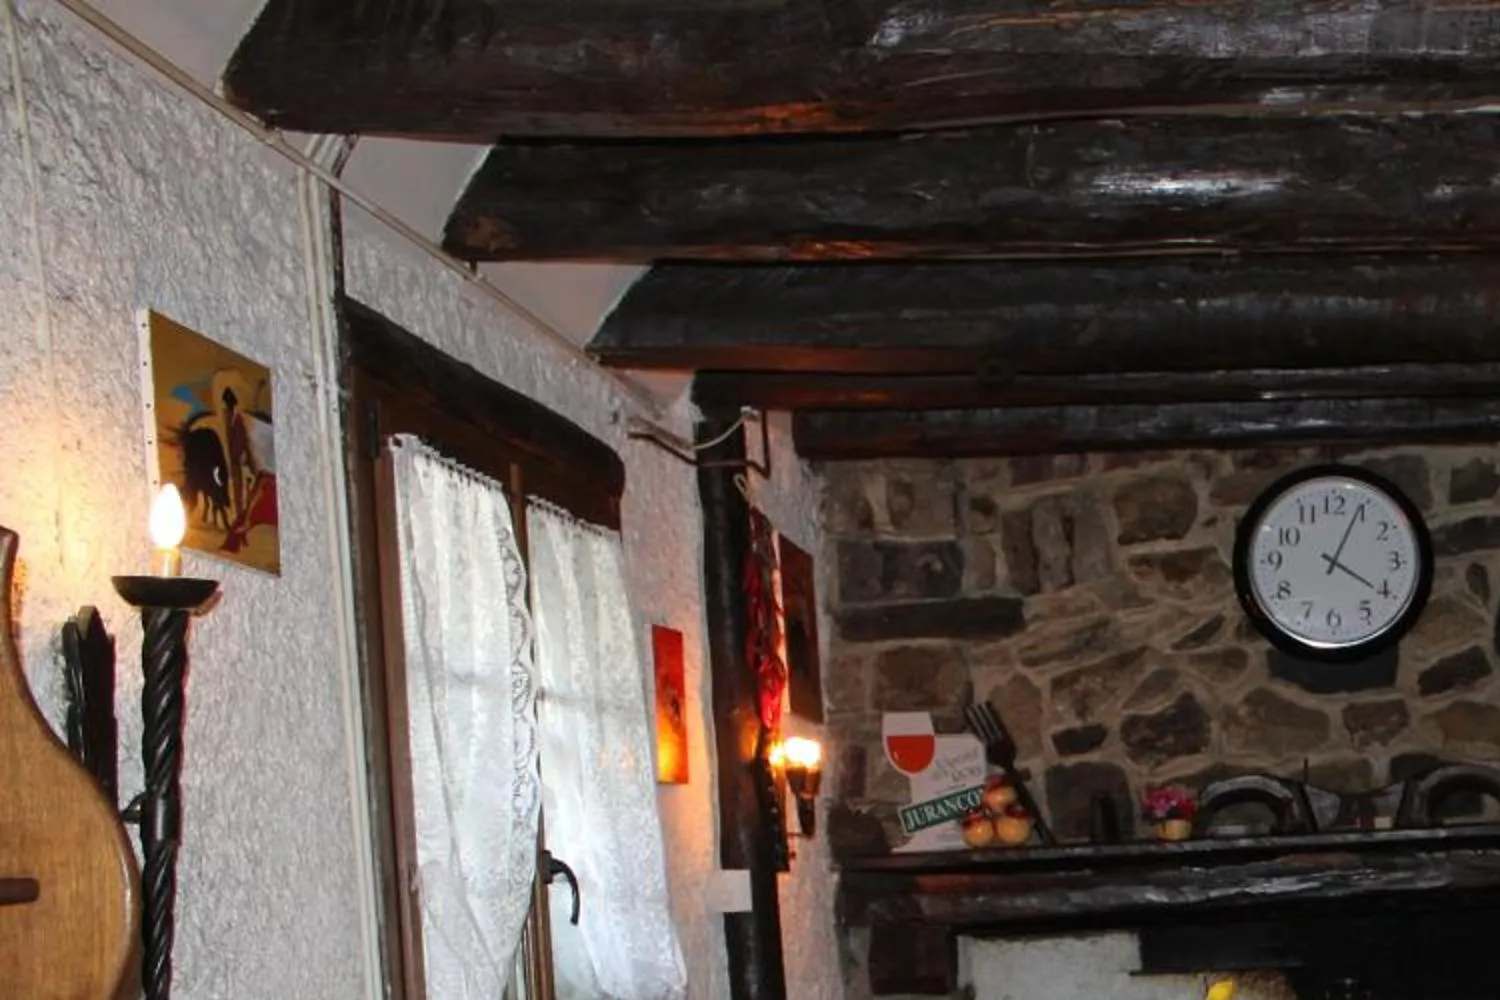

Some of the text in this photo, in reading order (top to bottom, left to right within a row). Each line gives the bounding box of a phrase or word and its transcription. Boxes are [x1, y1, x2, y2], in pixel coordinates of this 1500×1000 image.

[1299, 504, 1316, 524] 11
[1323, 495, 1345, 515] 12
[1278, 527, 1300, 546] 10
[1375, 522, 1389, 541] 2
[1268, 551, 1282, 570] 9
[1387, 552, 1400, 571] 3
[1277, 581, 1291, 600] 8
[1376, 580, 1390, 598] 4
[1301, 602, 1312, 620] 7
[1326, 609, 1341, 627] 6
[1359, 601, 1372, 621] 5
